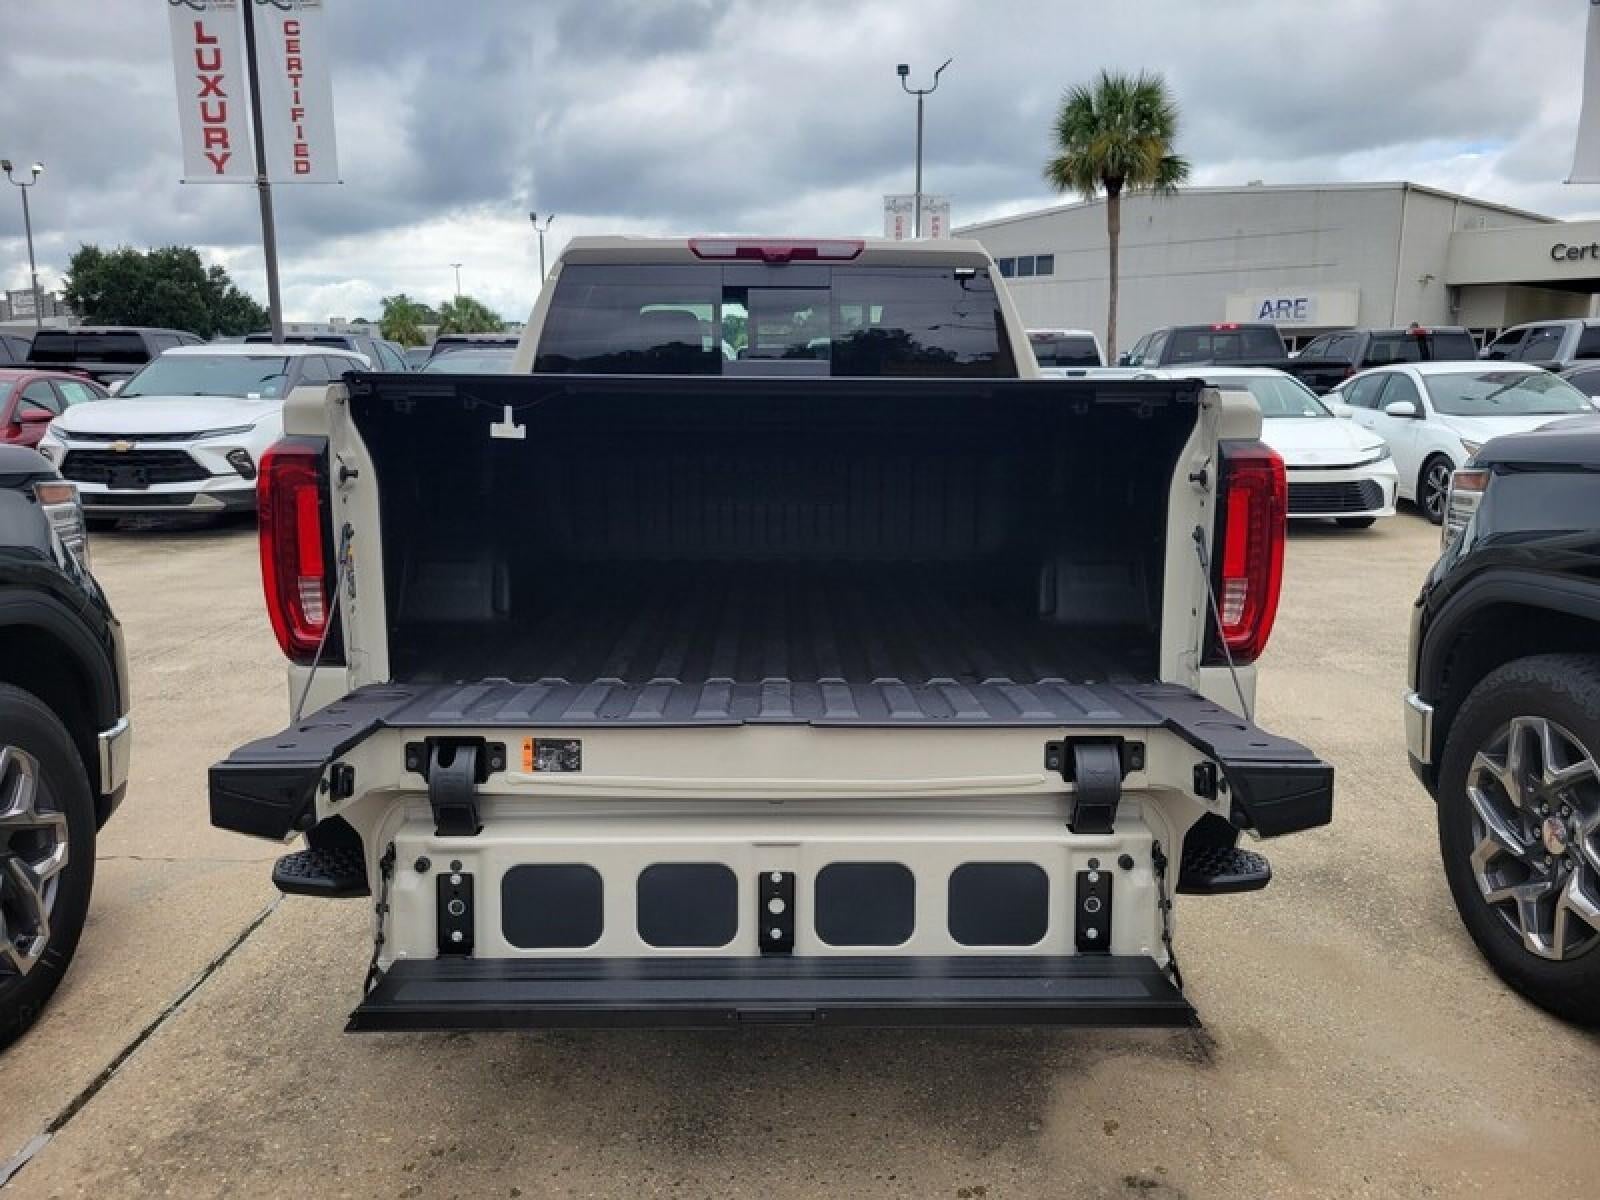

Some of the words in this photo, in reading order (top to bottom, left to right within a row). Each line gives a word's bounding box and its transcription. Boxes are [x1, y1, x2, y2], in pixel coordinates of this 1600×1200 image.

[194, 21, 232, 174] LUXURY
[284, 20, 310, 174] CERTIFIED
[1551, 242, 1600, 262] Cert
[1259, 298, 1309, 319] ARE
